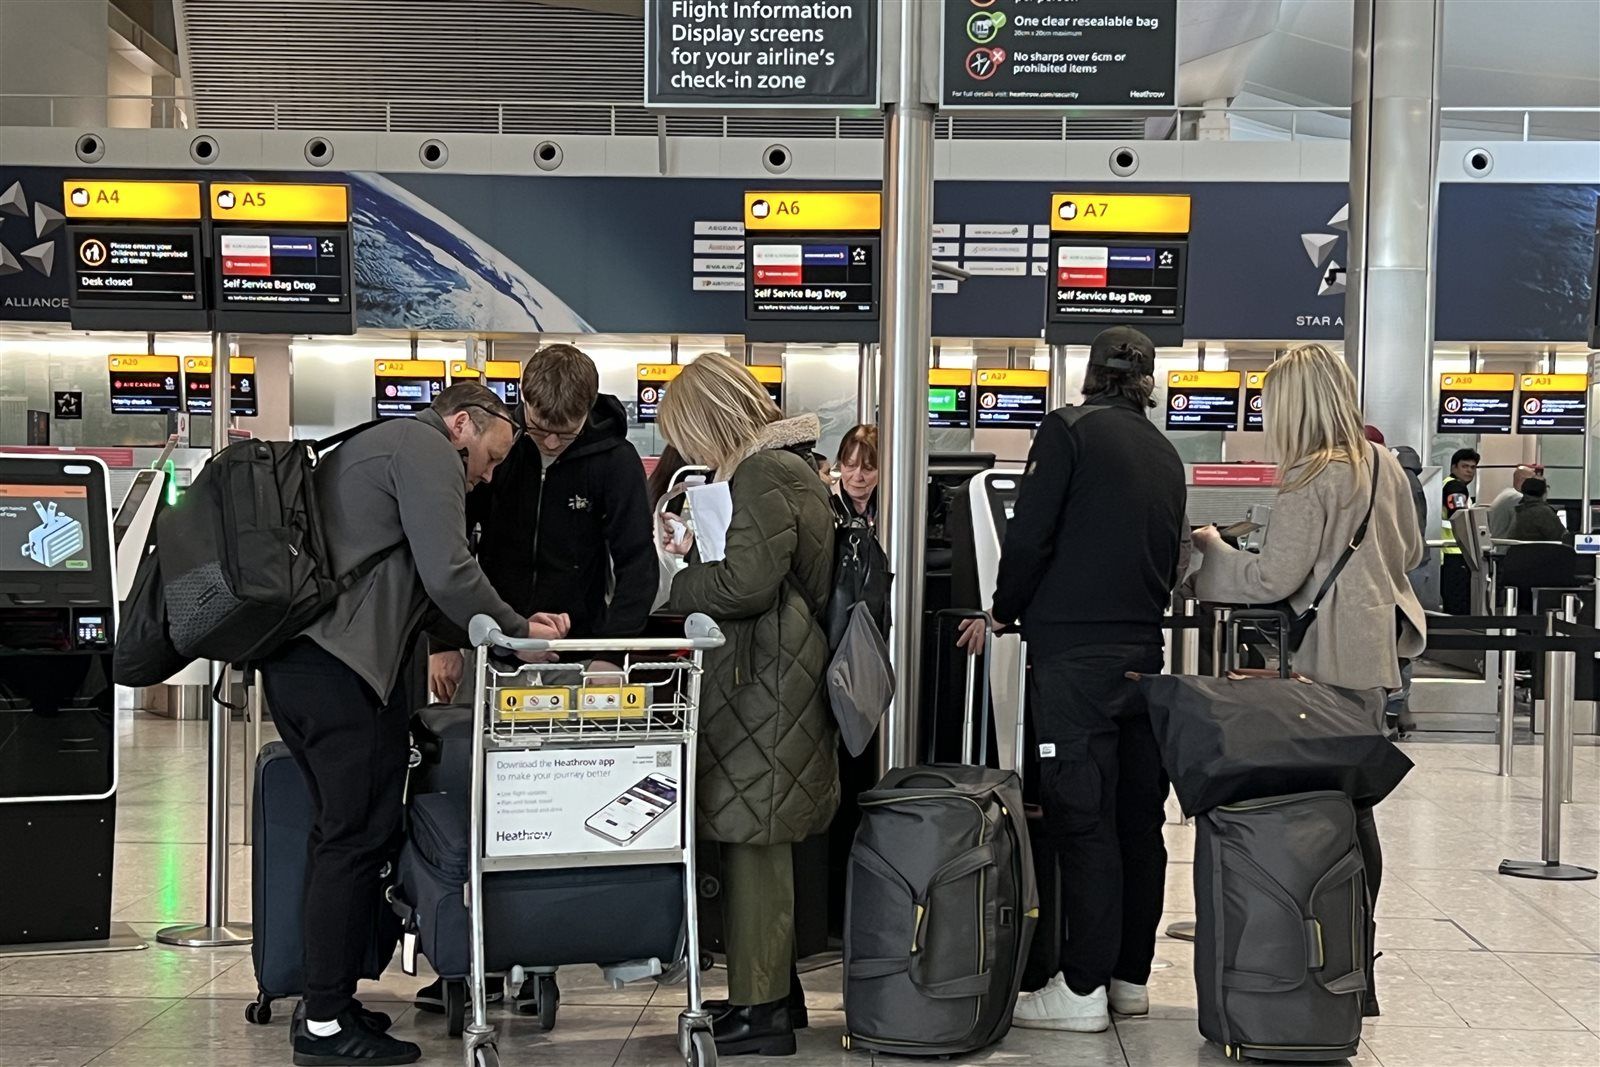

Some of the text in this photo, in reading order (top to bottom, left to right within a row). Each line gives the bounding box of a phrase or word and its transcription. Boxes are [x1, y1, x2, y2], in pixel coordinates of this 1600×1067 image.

[672, 1, 852, 21] Flight Information
[1014, 16, 1158, 30] One clear resealable bag
[672, 24, 824, 45] Display screens
[671, 47, 834, 69] for your airline’s
[1014, 52, 1126, 64] No sharps over 6cm or
[1014, 64, 1098, 75] prohibited items
[671, 71, 806, 88] check-in zone
[96, 190, 120, 204] A4
[242, 192, 266, 206] A5
[776, 200, 800, 215] A6
[1084, 203, 1108, 217] A7
[152, 251, 188, 259] supervised
[82, 276, 133, 286] Desk closed
[223, 280, 316, 291] Self Service Bag Drop
[754, 288, 847, 300] Self Service Bag Drop
[1057, 290, 1152, 304] Self Service Bag Drop
[4, 297, 70, 308] ALLIANCE
[1296, 316, 1330, 326] STAR
[496, 760, 538, 769] Download
[554, 758, 598, 767] Heathrow
[598, 759, 615, 767] app
[532, 773, 552, 781] your
[553, 772, 585, 781] journey
[496, 829, 552, 842] Heathrow
